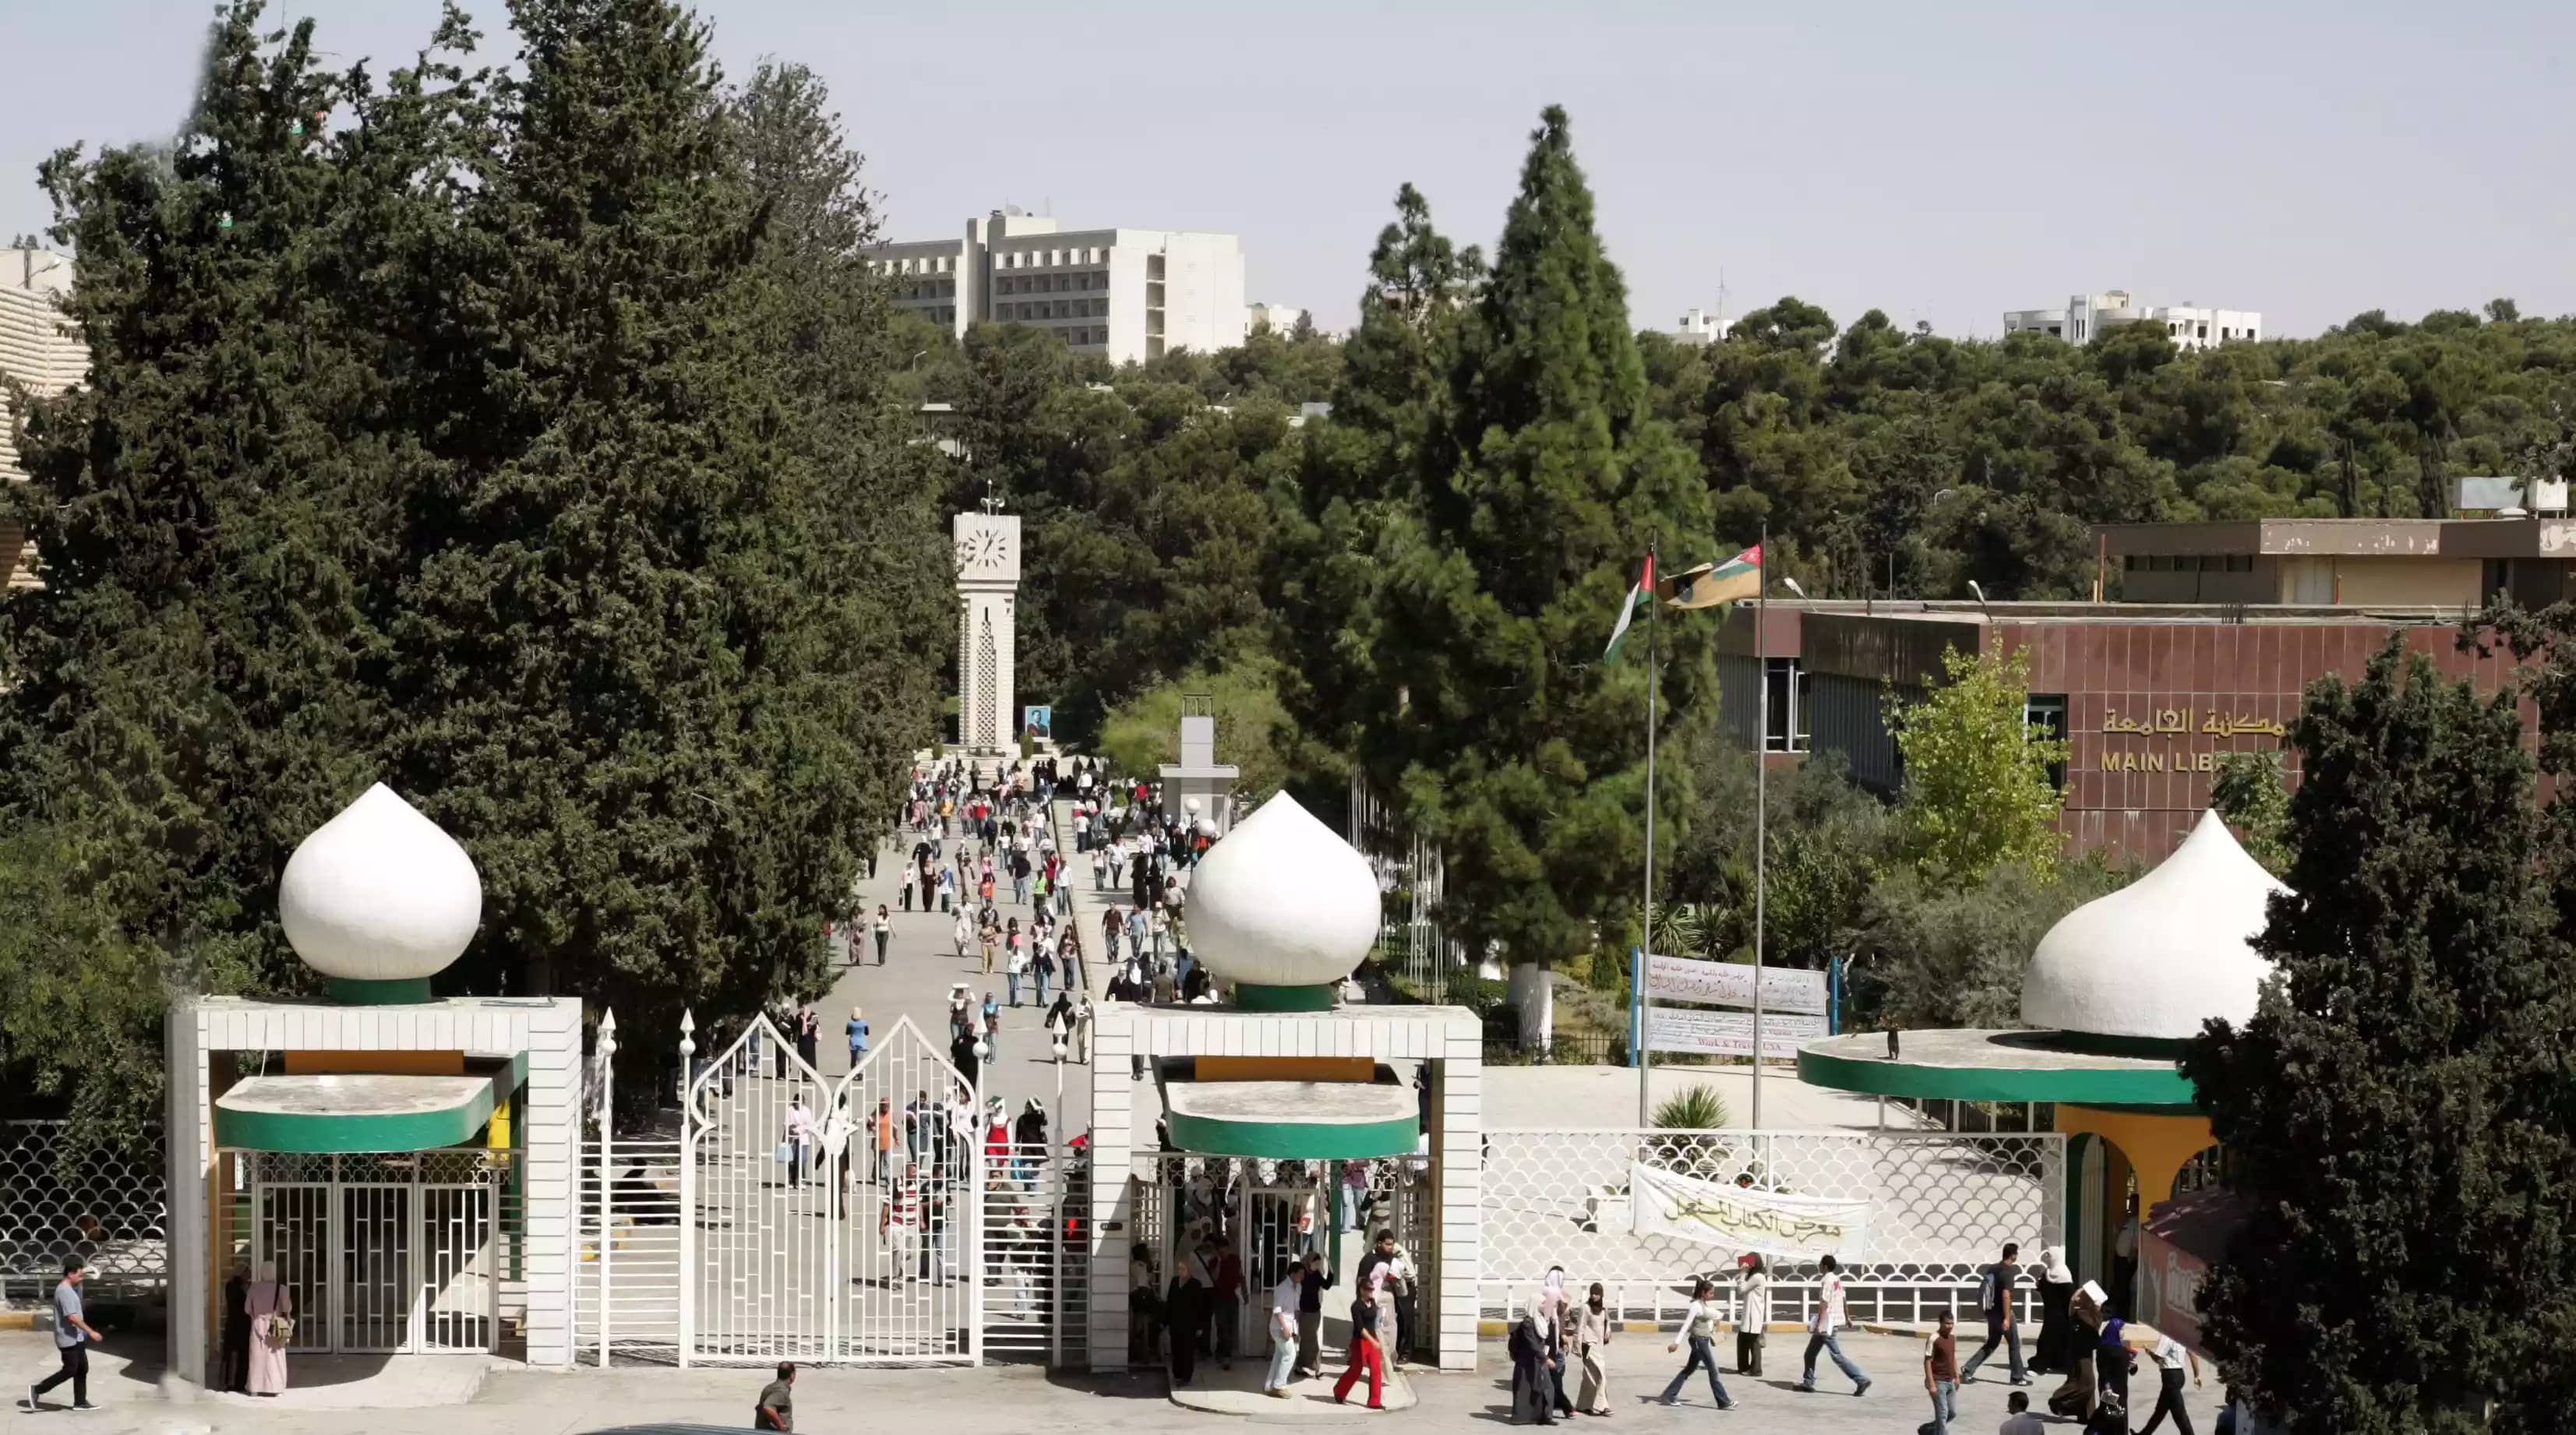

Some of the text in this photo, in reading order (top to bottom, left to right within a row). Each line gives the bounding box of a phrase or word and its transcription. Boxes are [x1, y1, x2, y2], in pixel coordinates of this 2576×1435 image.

[2102, 707, 2285, 739] مكتبة الجامعة
[2101, 752, 2164, 773] MAIN
[1732, 1040, 1754, 1049] Trav
[1721, 1208, 1779, 1232] الكتاب
[1780, 1218, 1841, 1243] معرض
